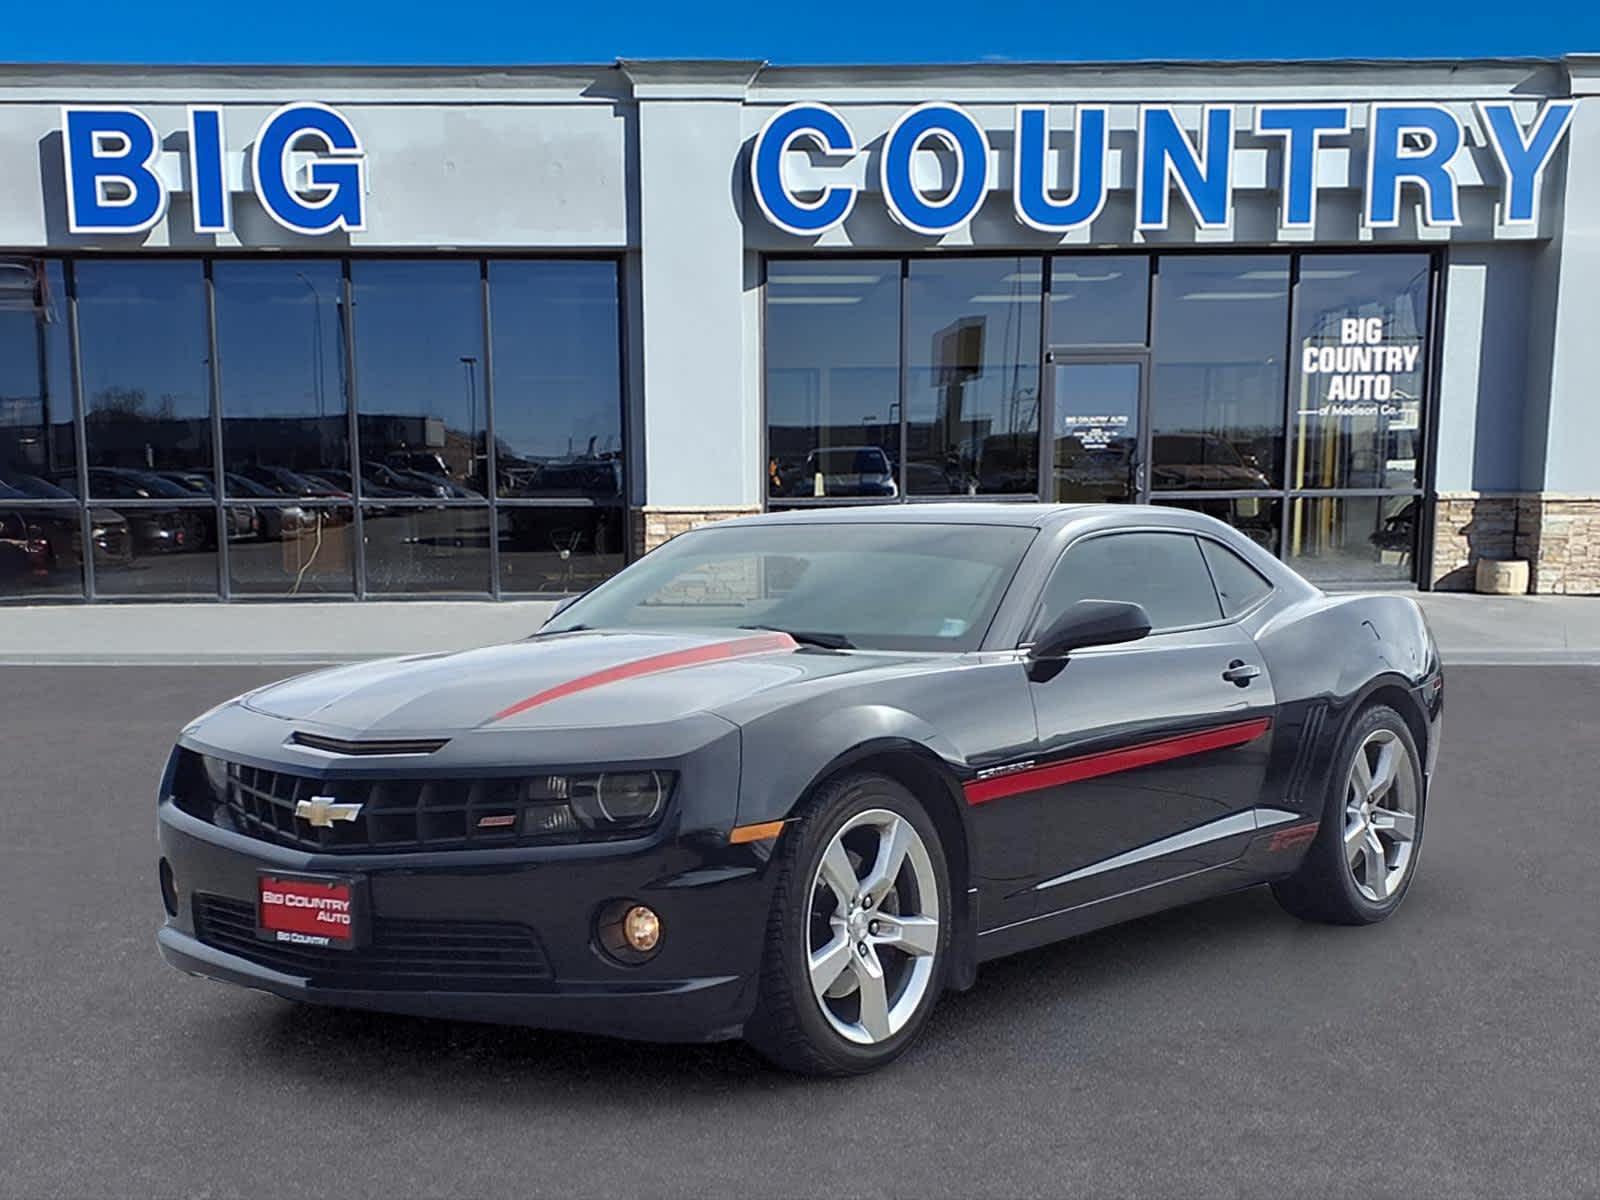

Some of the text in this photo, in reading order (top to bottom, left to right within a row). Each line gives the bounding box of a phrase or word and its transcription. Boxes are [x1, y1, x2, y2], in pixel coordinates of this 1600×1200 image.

[61, 100, 1576, 236] BIG COUNTRY
[1341, 318, 1382, 344] BIG
[1303, 346, 1419, 373] COUNTRY
[1328, 375, 1391, 401] AUTO
[1332, 404, 1377, 415] Madison
[263, 891, 350, 911] BIG COUNTRY
[316, 911, 350, 924] AUTO
[291, 933, 329, 945] COUNTRY
